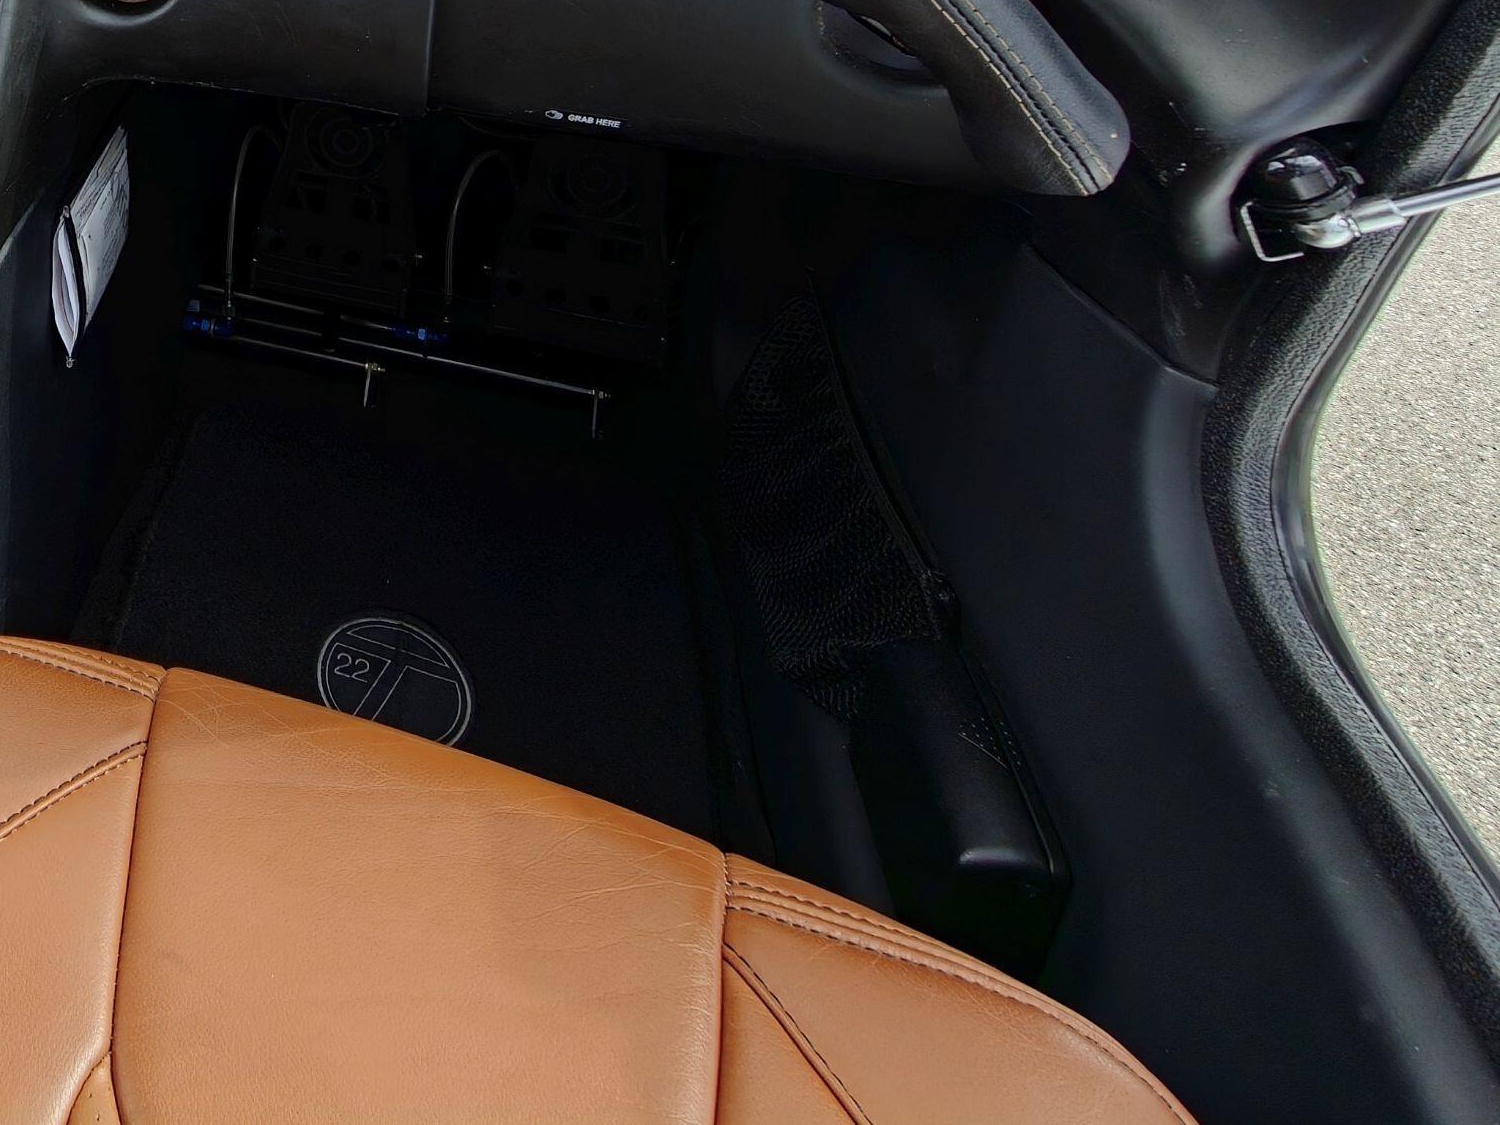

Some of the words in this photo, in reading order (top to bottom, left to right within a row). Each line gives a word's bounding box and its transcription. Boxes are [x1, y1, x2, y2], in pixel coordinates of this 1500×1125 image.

[567, 114, 595, 124] GRAB
[595, 118, 621, 128] HERE
[334, 652, 370, 683] 22
